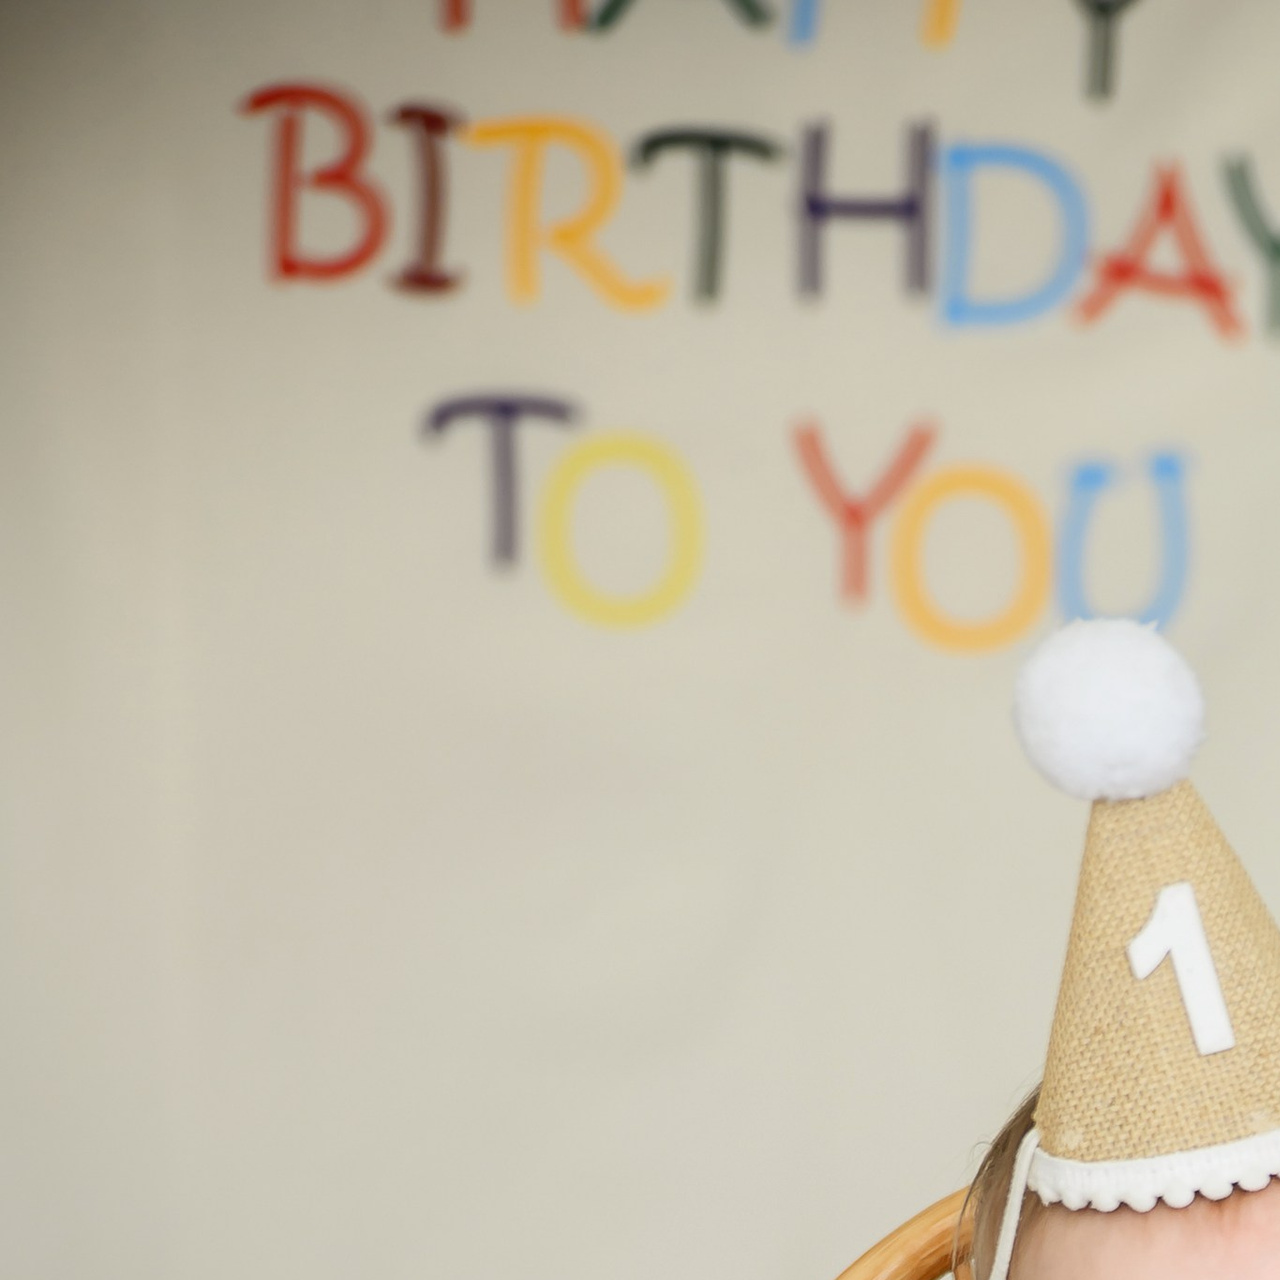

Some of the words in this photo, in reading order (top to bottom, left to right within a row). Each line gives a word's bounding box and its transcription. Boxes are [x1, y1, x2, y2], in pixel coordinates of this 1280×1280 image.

[424, 392, 708, 630] TO
[790, 417, 1194, 655] YOU
[1126, 879, 1236, 1057] 1
